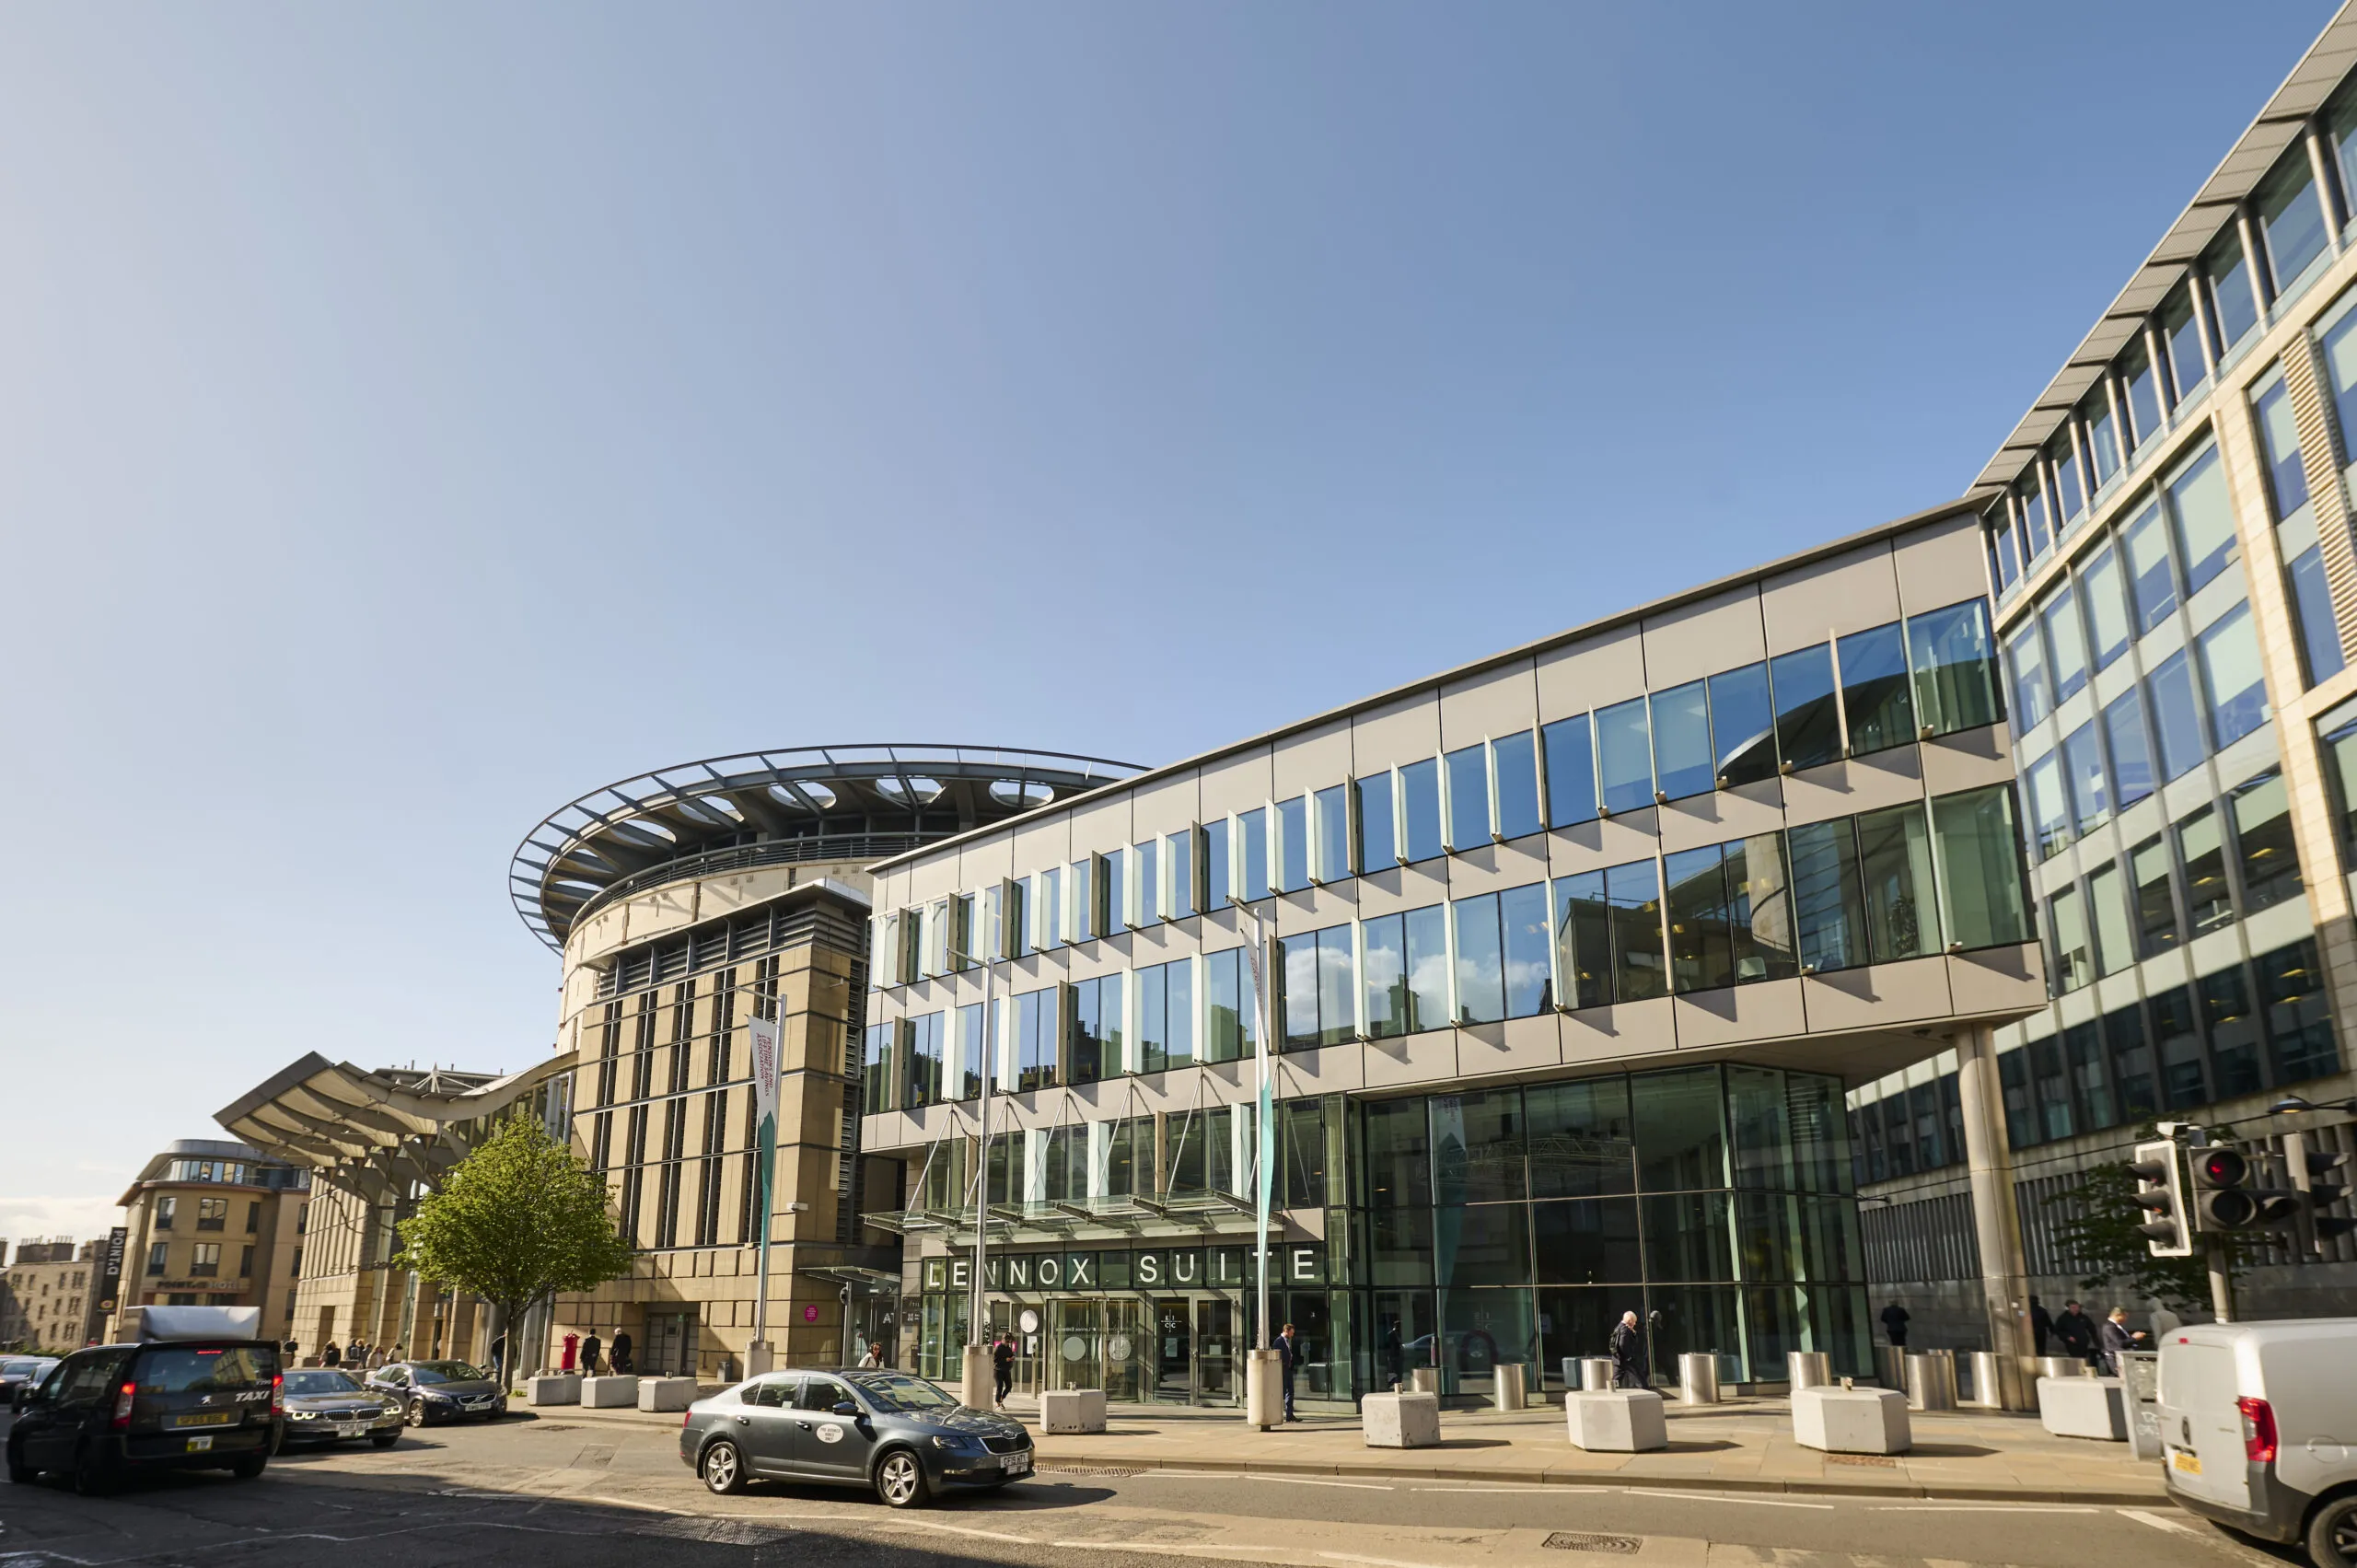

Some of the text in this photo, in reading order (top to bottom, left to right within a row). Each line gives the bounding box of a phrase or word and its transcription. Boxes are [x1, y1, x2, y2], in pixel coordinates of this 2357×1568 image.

[756, 1032, 764, 1080] ASSOCIATION
[928, 1258, 1090, 1286] LENNOX
[235, 1390, 271, 1402] TAXI
